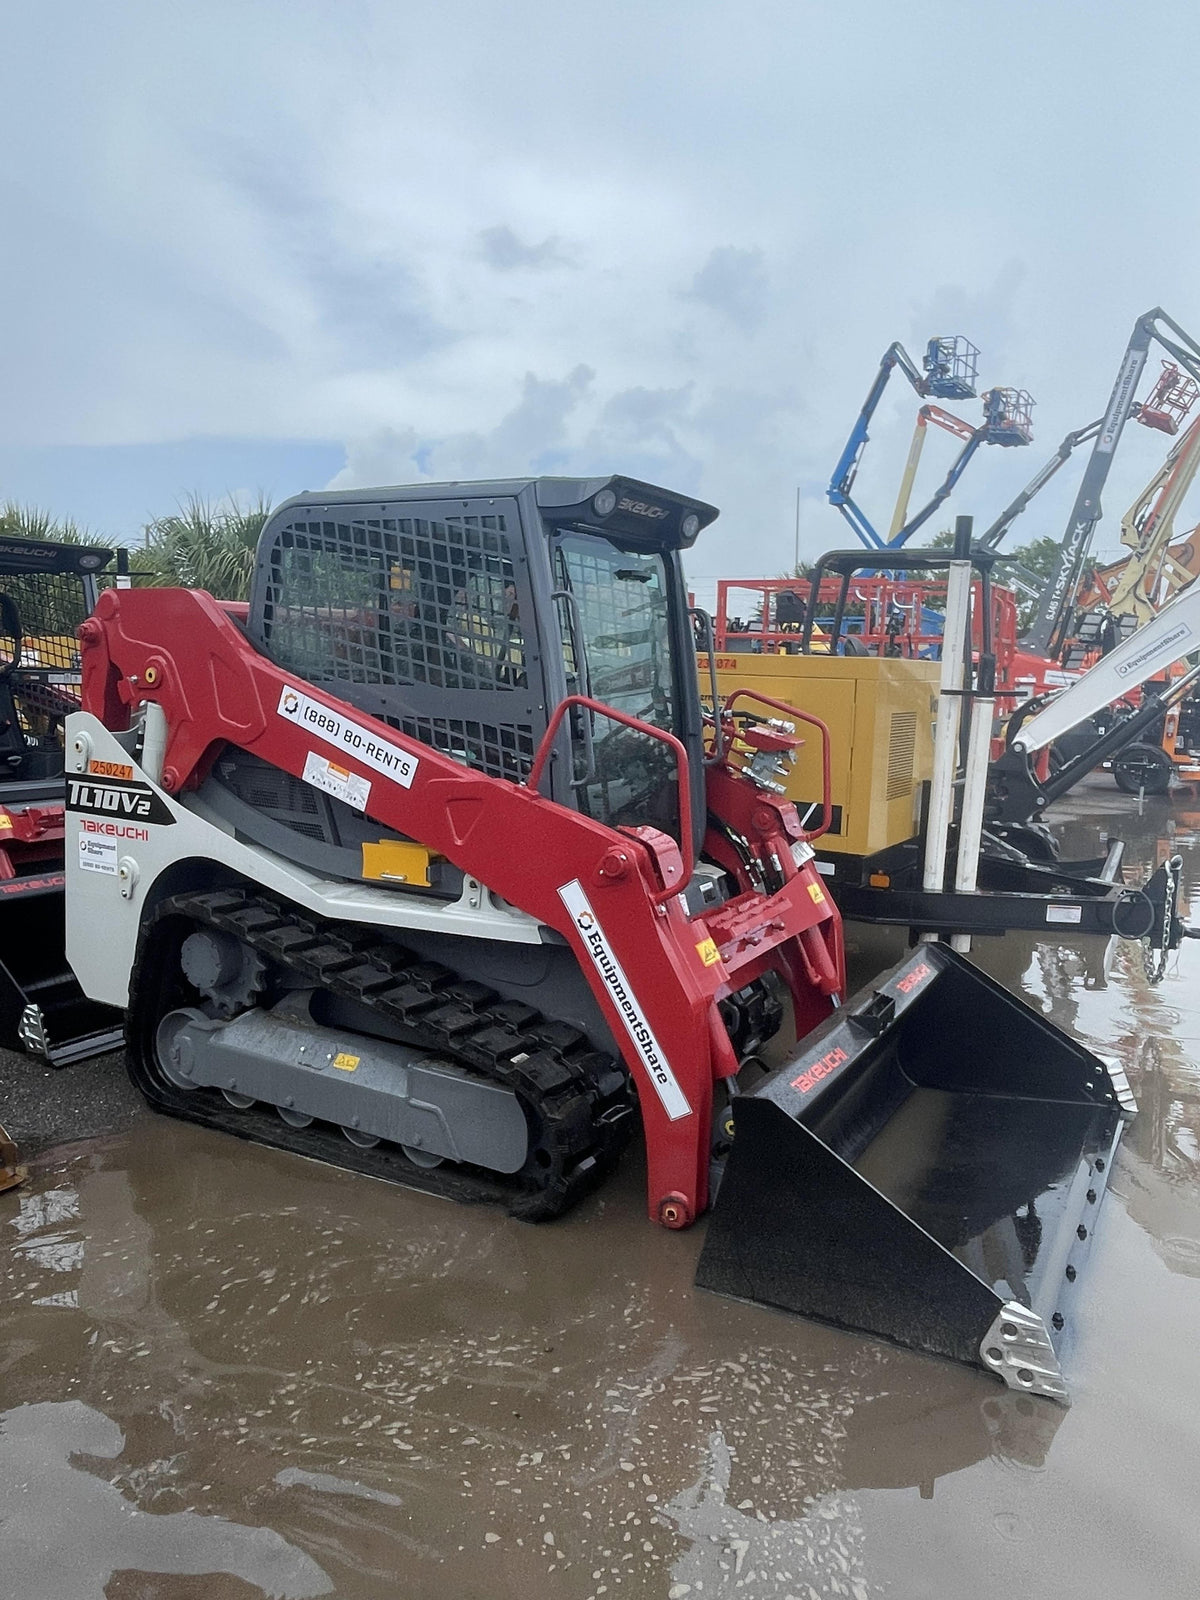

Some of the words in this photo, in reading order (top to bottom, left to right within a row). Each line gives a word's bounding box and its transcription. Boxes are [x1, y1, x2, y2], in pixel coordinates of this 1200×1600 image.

[1056, 522, 1087, 590] SKYJACK
[304, 706, 341, 736] (888)
[343, 729, 411, 776] 80-RENTS
[92, 760, 133, 778] 250247
[68, 780, 152, 816] TL10V2
[80, 819, 149, 841] TAKEUCHI
[587, 930, 668, 1085] EquipmentShare
[790, 1046, 848, 1093] TAKEUCHI
